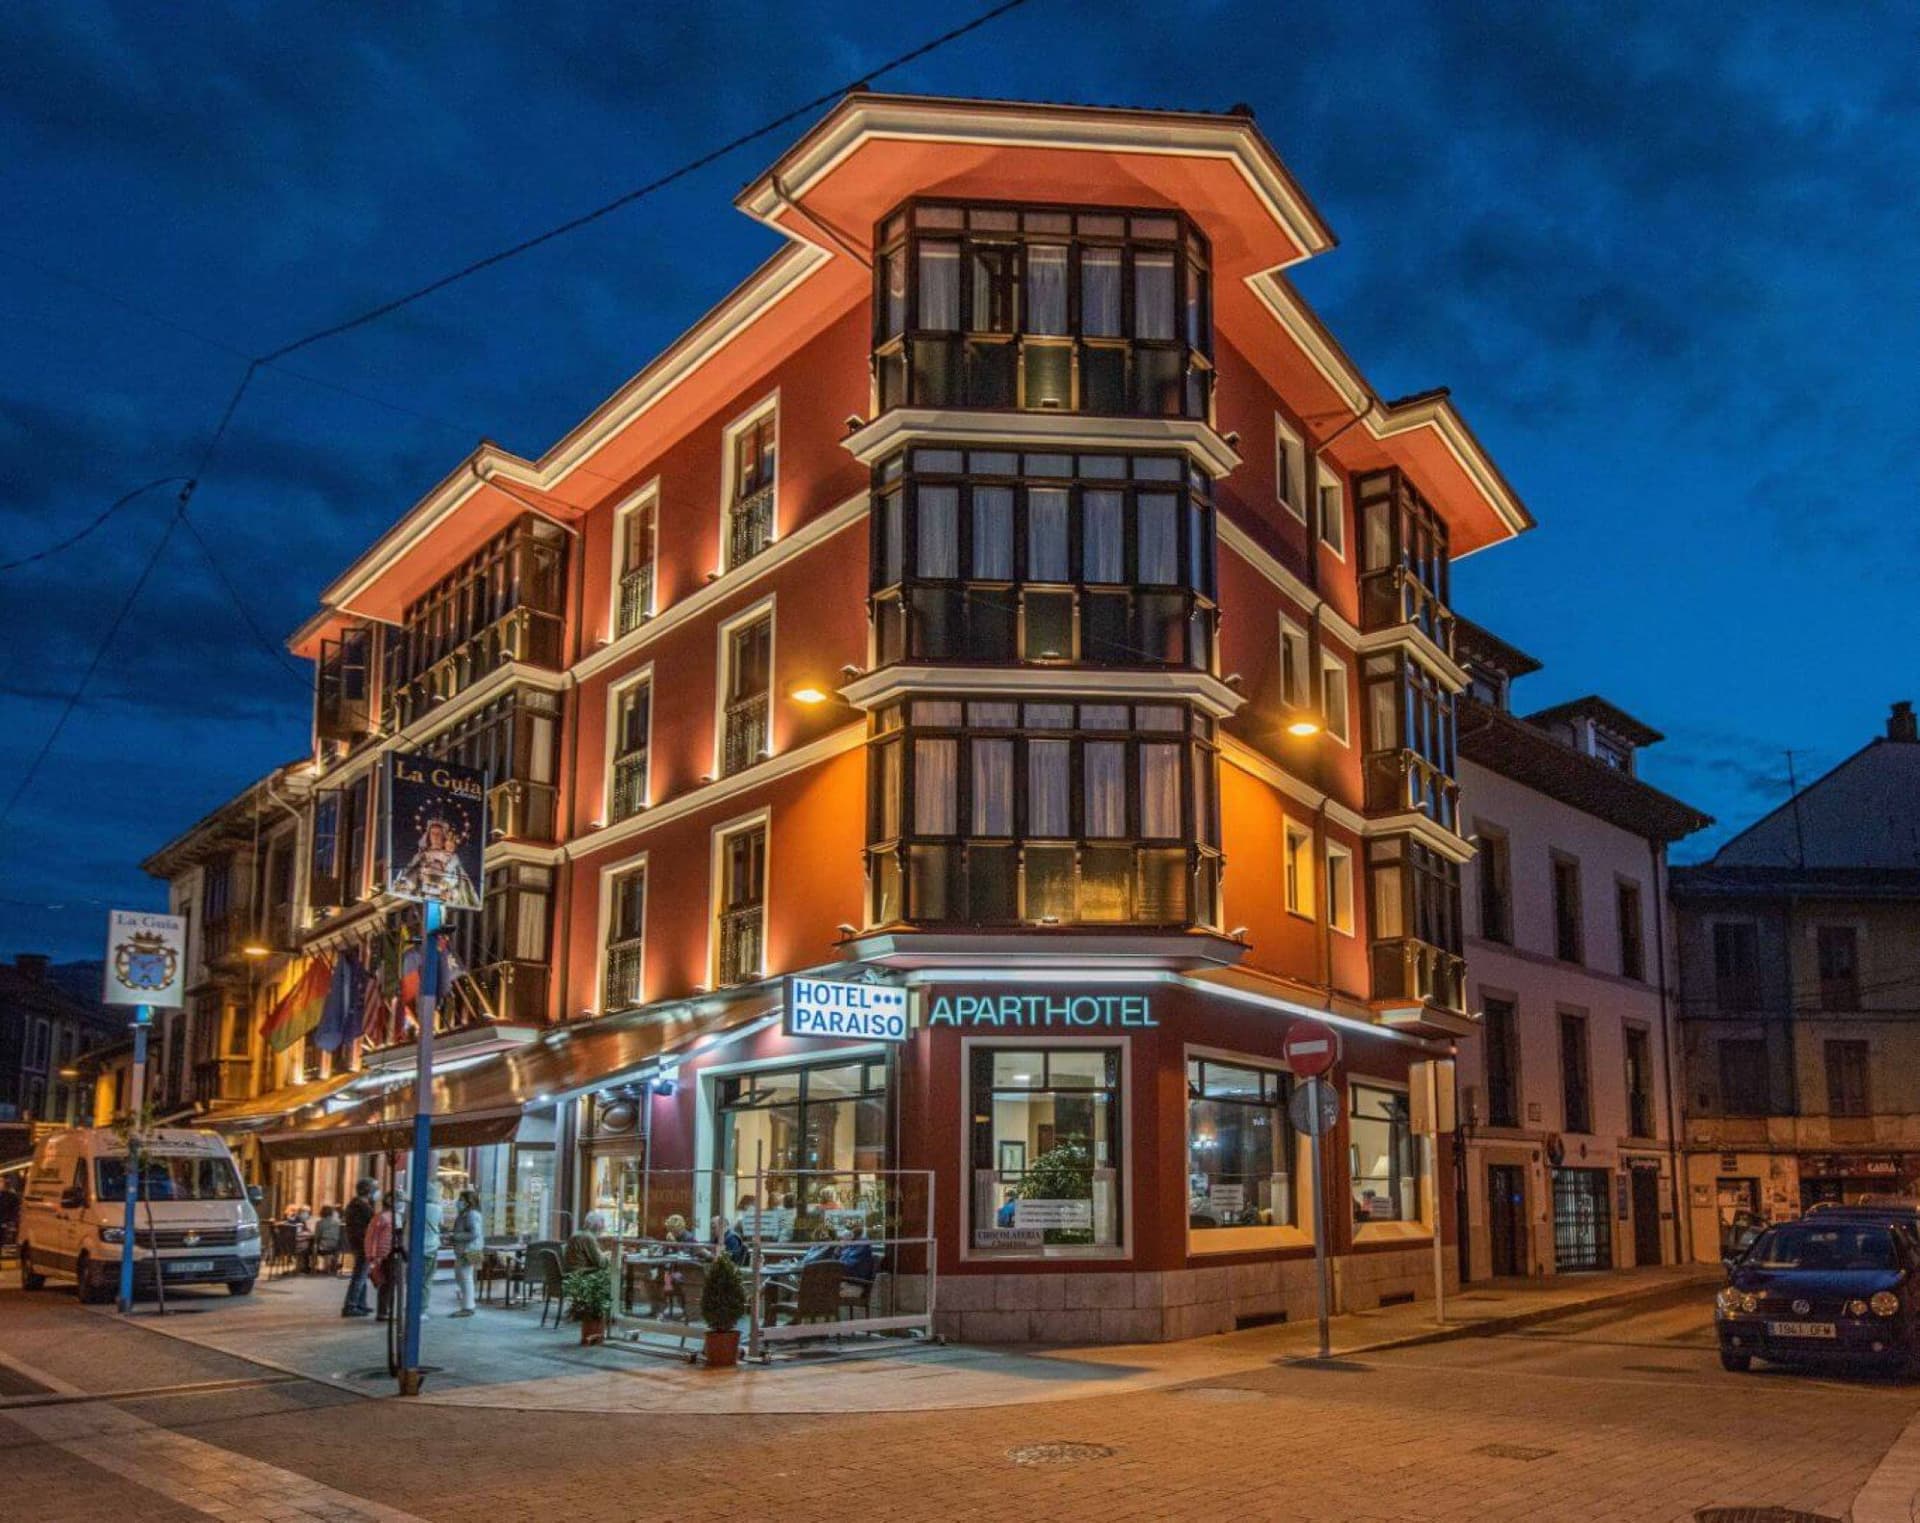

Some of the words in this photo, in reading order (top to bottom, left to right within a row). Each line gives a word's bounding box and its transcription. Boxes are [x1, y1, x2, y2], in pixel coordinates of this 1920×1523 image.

[395, 760, 424, 784] La
[117, 914, 137, 926] La
[795, 981, 873, 1009] HOTEL
[795, 1008, 905, 1037] PARAISO
[928, 996, 1160, 1028] APARTHOTEL
